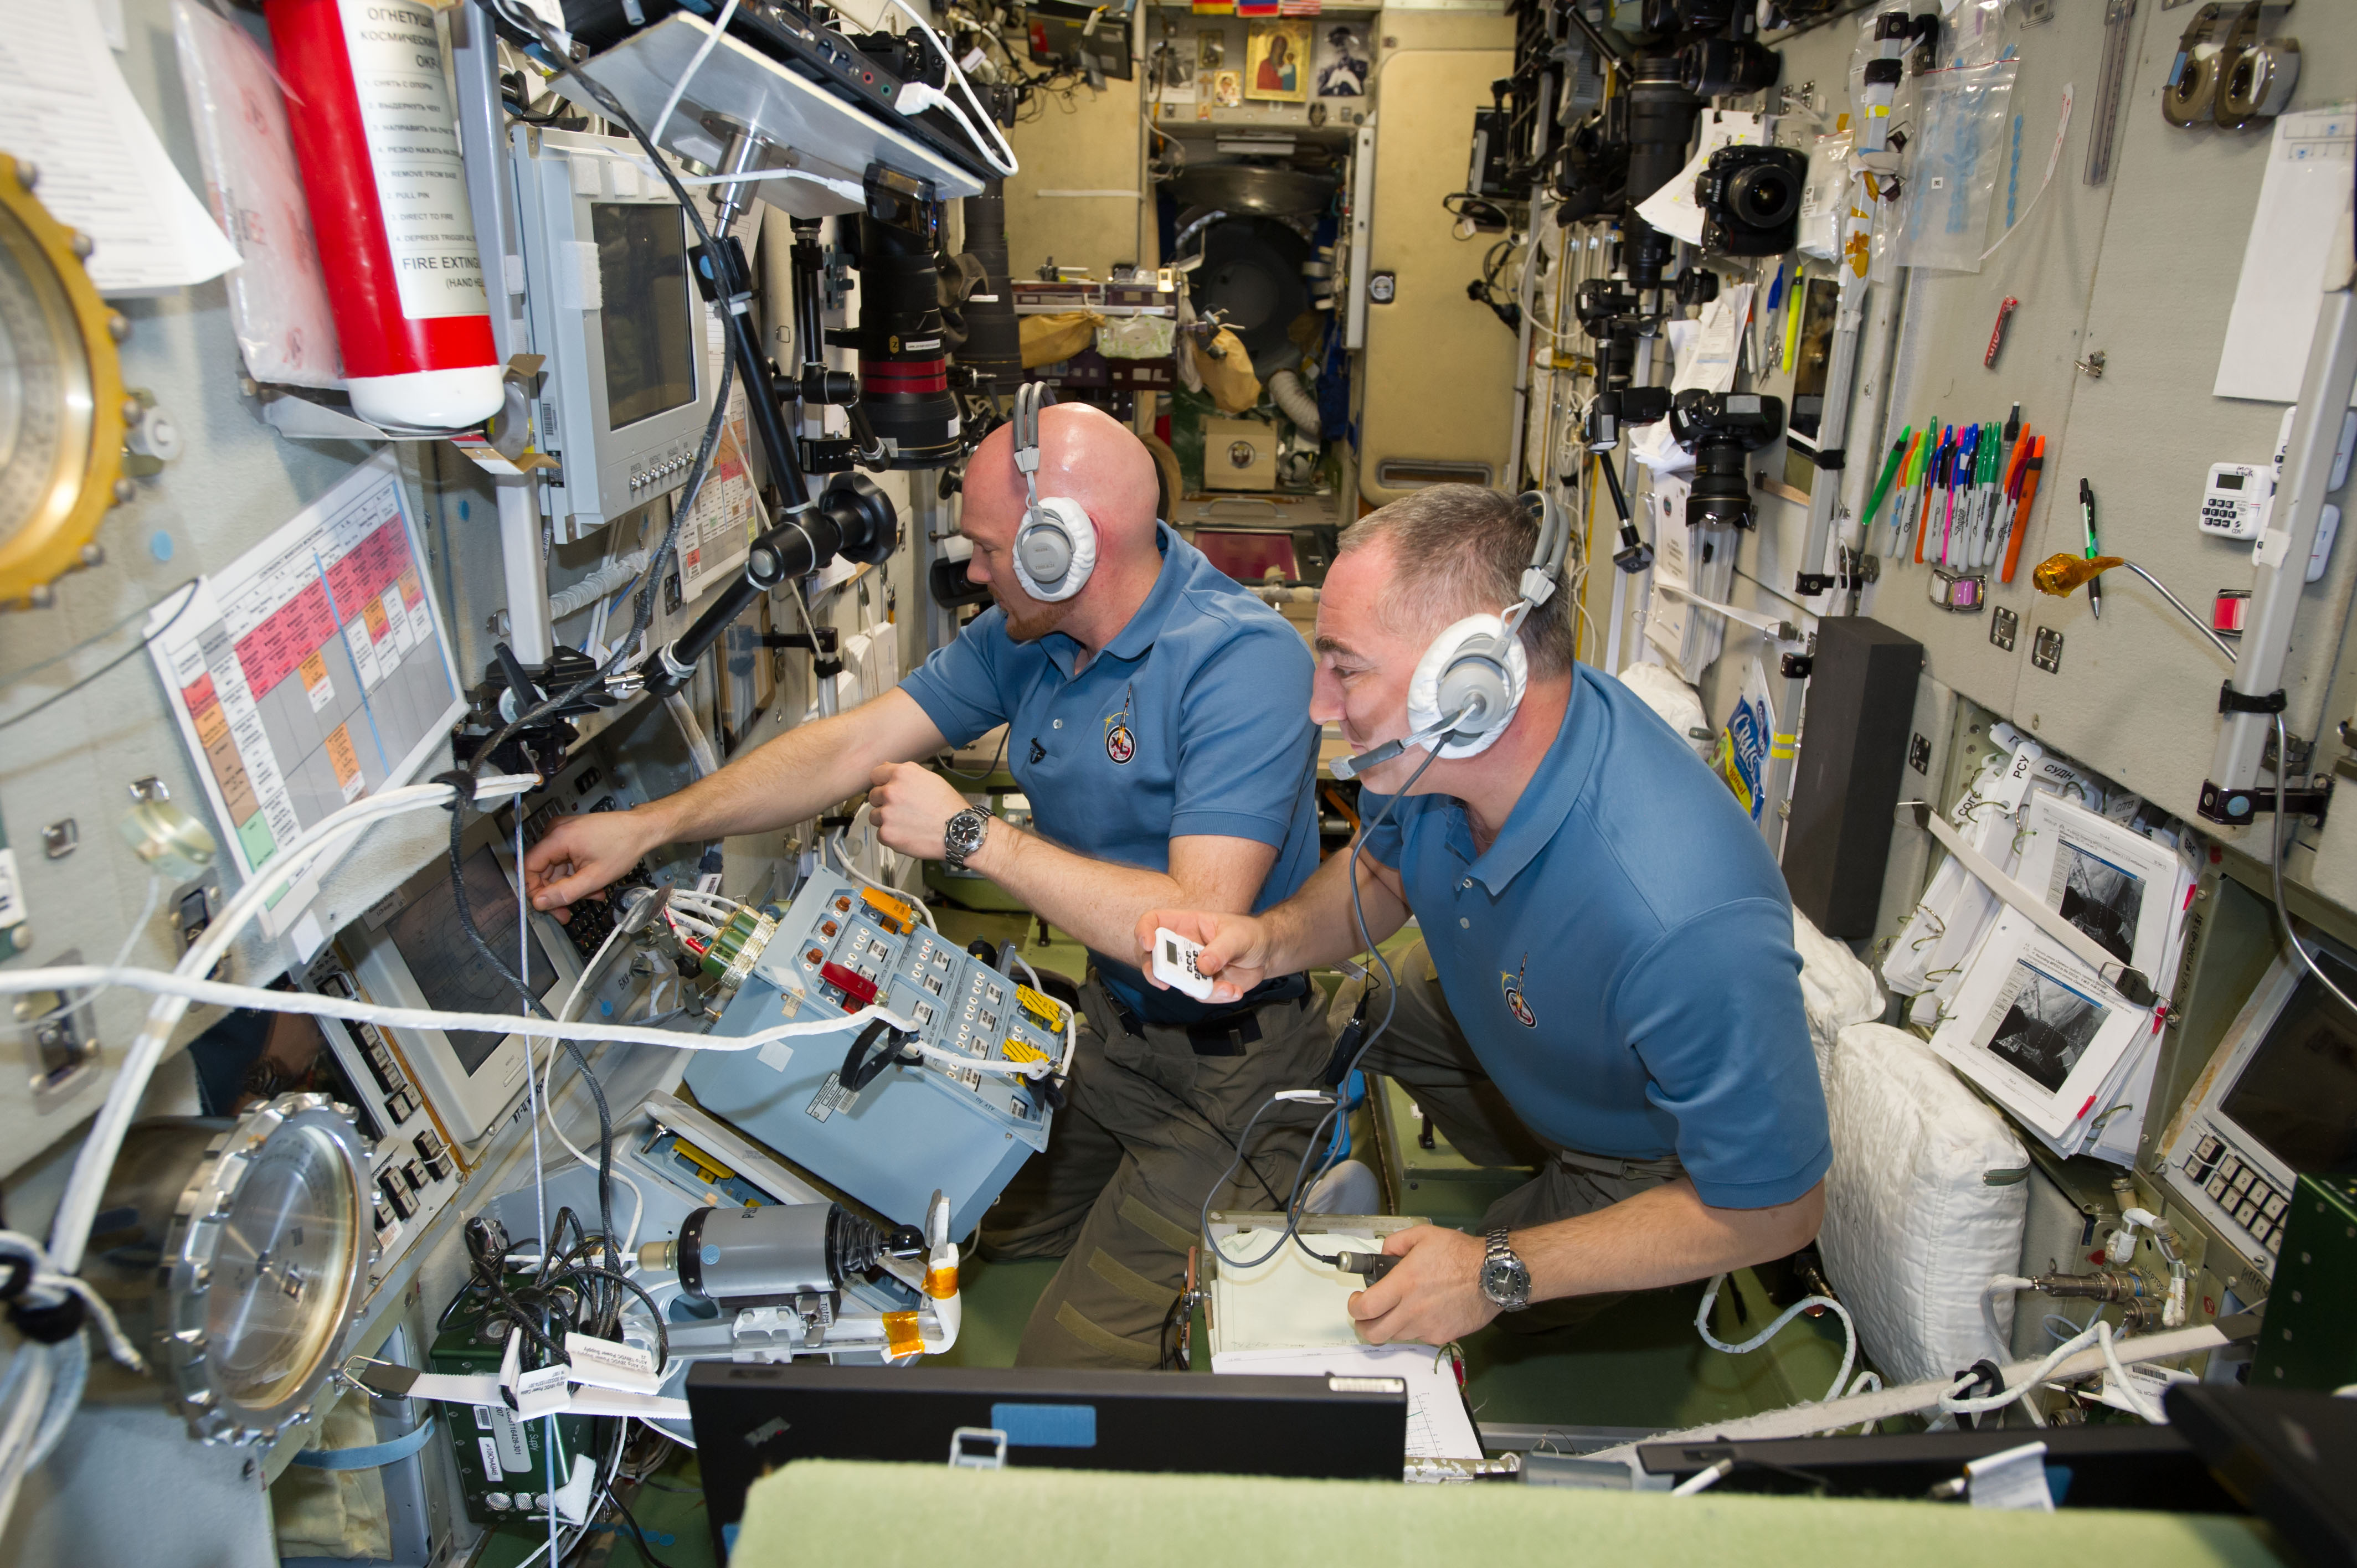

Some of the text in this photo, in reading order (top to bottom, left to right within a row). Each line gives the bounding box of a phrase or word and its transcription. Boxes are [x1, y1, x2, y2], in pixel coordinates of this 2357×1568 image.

[1712, 179, 1722, 203] Nikon
[403, 257, 438, 270] FIRE
[446, 278, 474, 290] (HAND
[2013, 754, 2030, 780] РСУ
[2044, 764, 2076, 781] СУДН
[2183, 836, 2197, 858] БВС
[529, 1434, 539, 1452] Supply
